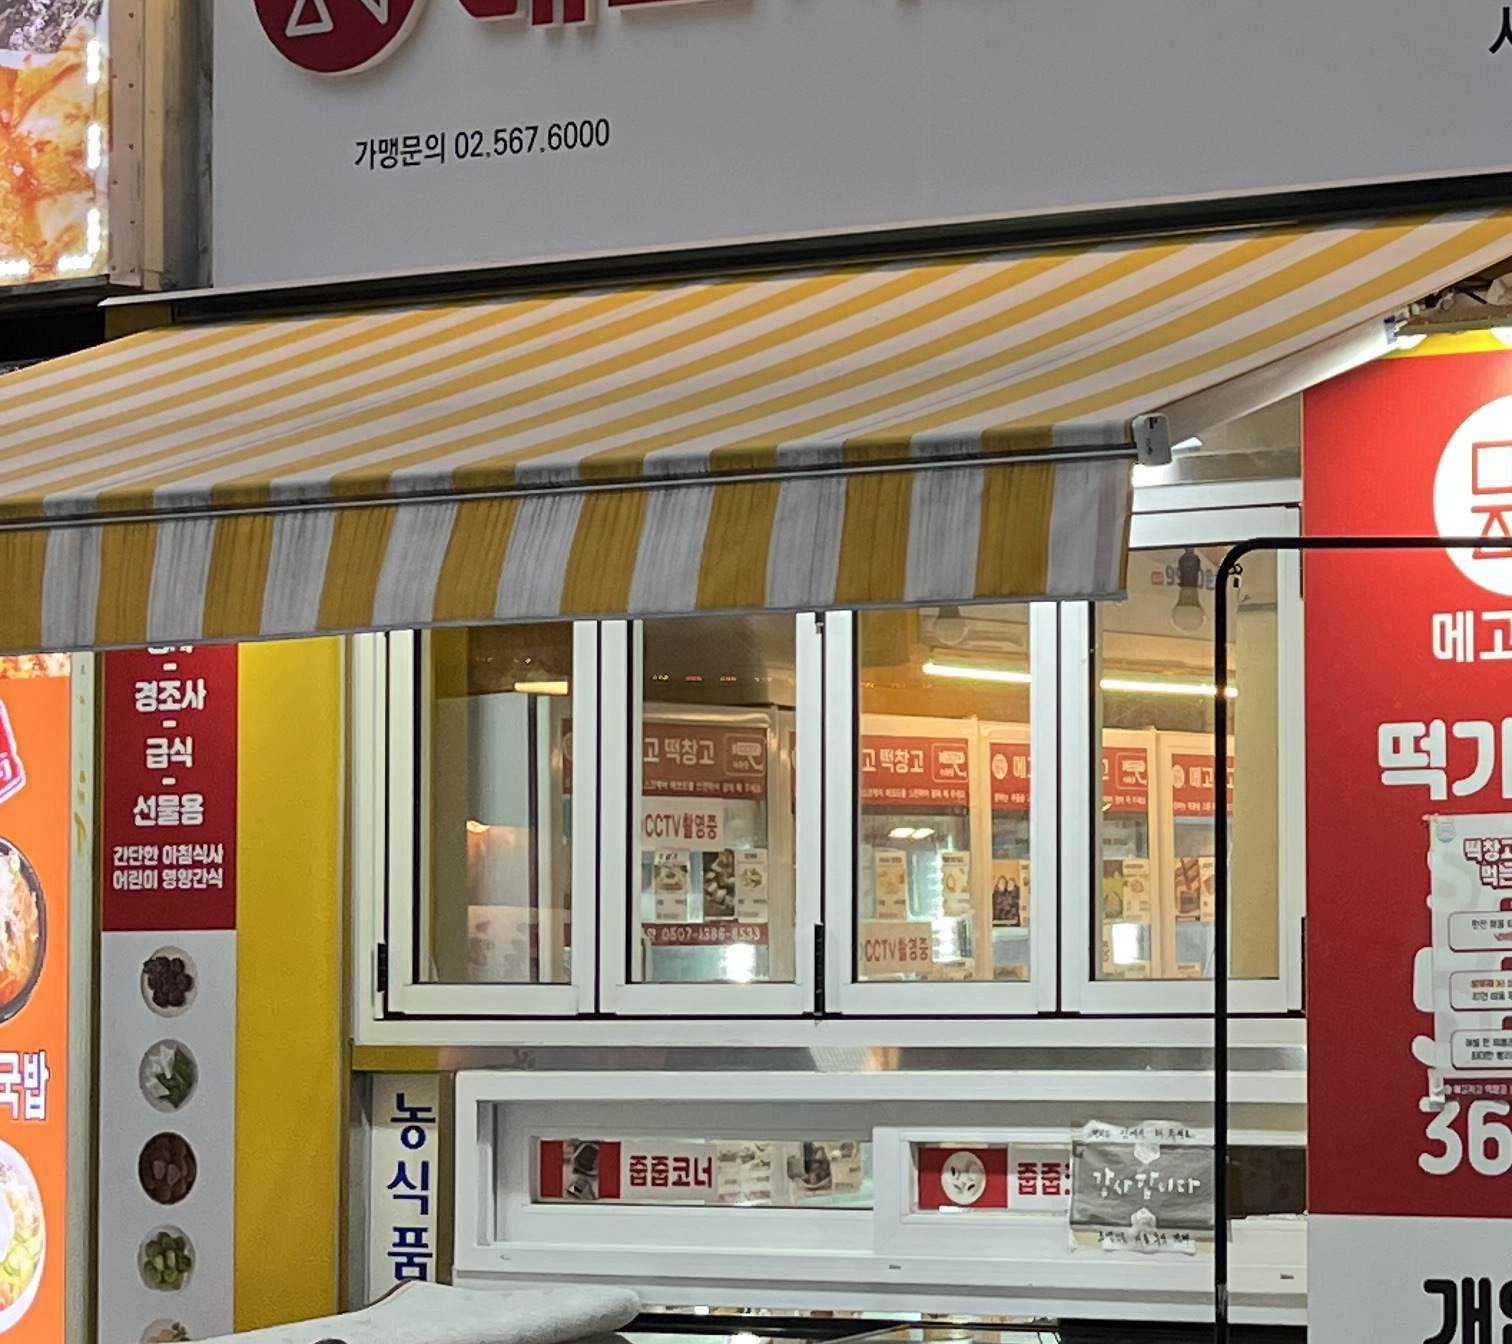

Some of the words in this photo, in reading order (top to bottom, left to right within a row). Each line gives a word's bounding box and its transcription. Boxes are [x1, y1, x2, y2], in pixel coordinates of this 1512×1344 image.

[354, 131, 446, 171] 가맹문의
[454, 118, 611, 161] 02.567.6000
[135, 679, 207, 712] 경조사
[146, 736, 193, 769] 급식
[664, 738, 716, 765] 떡창고
[879, 748, 925, 774] 떡창고
[133, 794, 204, 826] 선물용
[113, 845, 158, 866] 간단한
[162, 844, 224, 866] 아침식사
[113, 868, 158, 890] 어린이
[162, 867, 224, 890] 영양간식
[387, 1092, 437, 1281] 농식품
